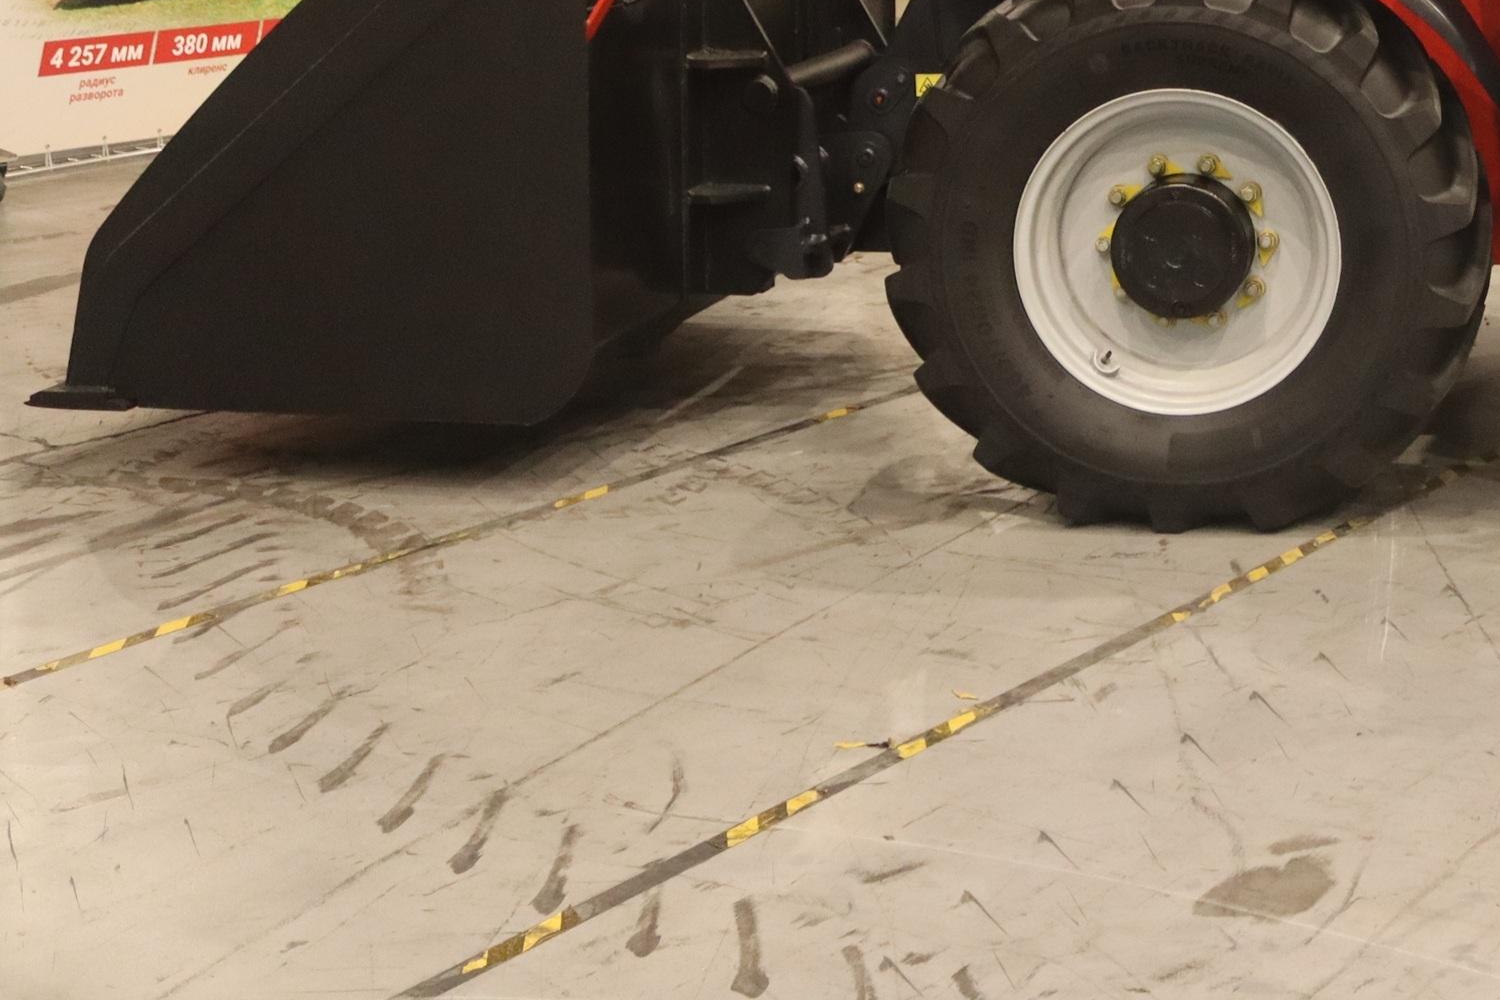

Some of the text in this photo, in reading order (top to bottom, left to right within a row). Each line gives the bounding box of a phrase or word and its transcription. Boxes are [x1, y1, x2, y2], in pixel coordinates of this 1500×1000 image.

[172, 33, 208, 56] 380
[50, 47, 63, 69] 4
[68, 43, 108, 67] 257
[188, 63, 228, 76] клиренс
[79, 76, 117, 90] радиус
[69, 88, 124, 104] разворота
